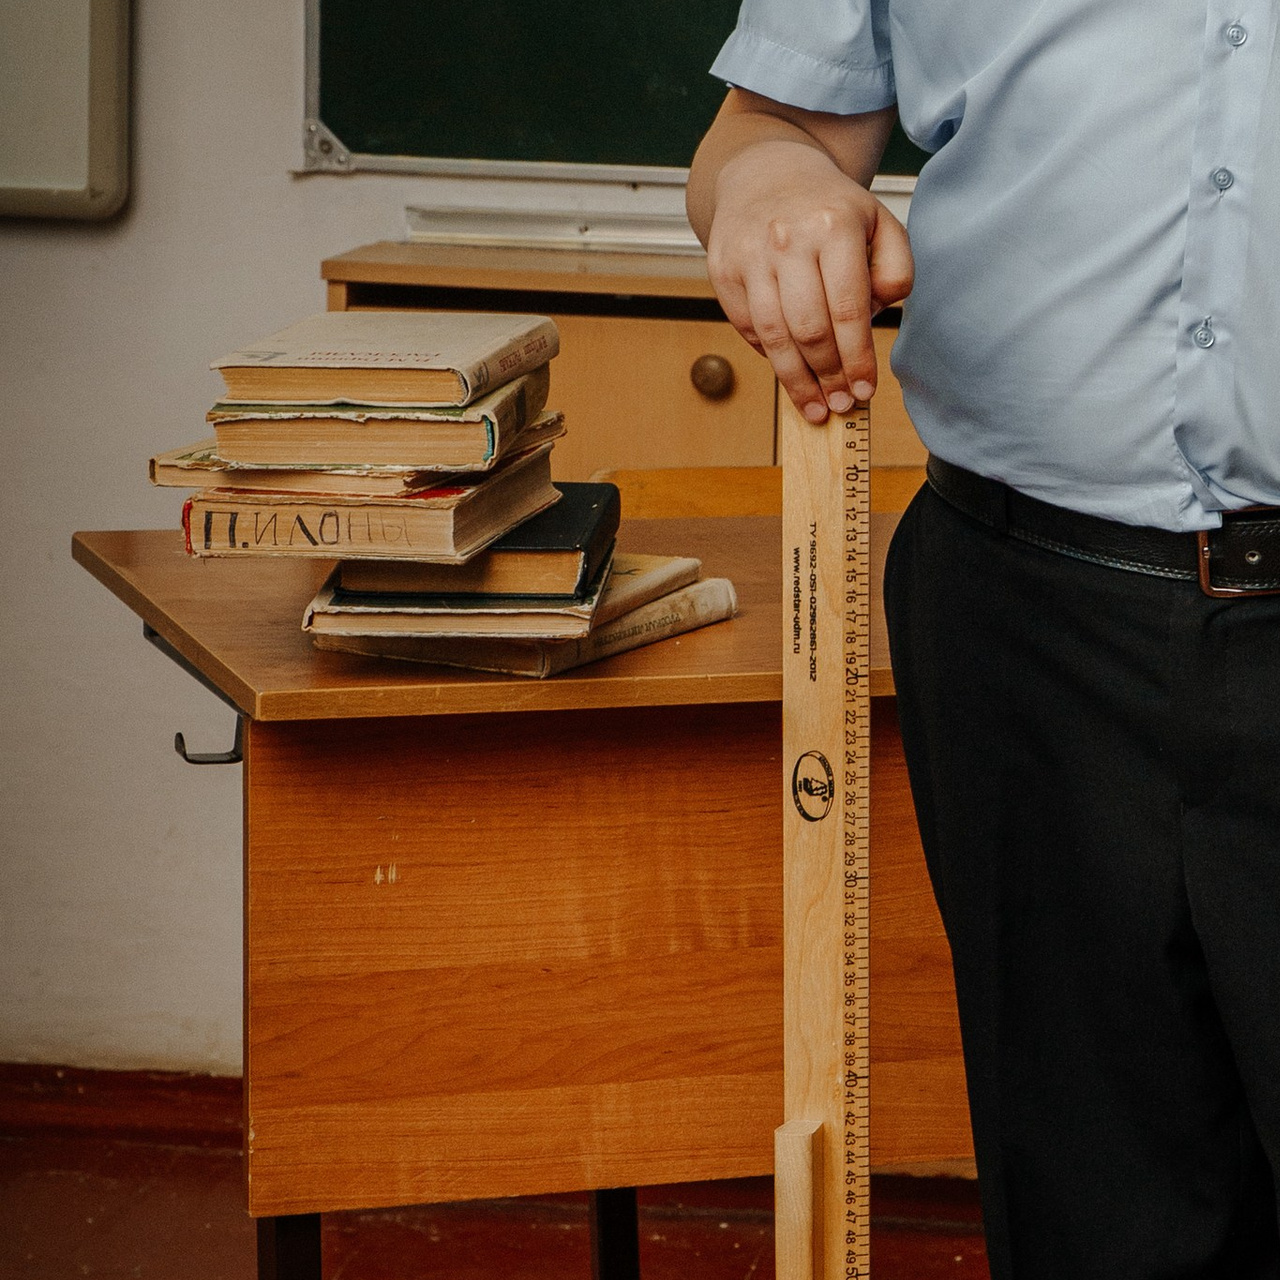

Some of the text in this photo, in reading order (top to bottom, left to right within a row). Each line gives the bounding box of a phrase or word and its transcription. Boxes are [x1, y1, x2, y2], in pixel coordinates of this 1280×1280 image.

[846, 465, 858, 481] 10
[846, 487, 856, 497] 11
[846, 507, 856, 520] 12
[846, 528, 856, 541] 13
[846, 548, 856, 561] 14
[846, 568, 856, 582] 15
[793, 547, 802, 654] www.redstar-udm.ru
[846, 590, 856, 603] 16
[846, 610, 856, 623] 17
[846, 630, 856, 643] 18
[846, 651, 856, 664] 19
[846, 668, 858, 685] 20
[846, 690, 856, 702] 21
[846, 710, 856, 724] 22
[845, 730, 856, 745] 23
[845, 750, 856, 764] 24
[845, 771, 856, 785] 25
[845, 791, 856, 805] 26
[845, 812, 856, 826] 27
[845, 832, 856, 845] 28
[845, 852, 856, 866] 29
[845, 871, 858, 887] 30
[845, 892, 855, 905] 31
[845, 912, 855, 926] 32
[845, 932, 855, 946] 33
[845, 952, 855, 965] 34
[845, 972, 855, 986] 35
[845, 992, 855, 1006] 36
[845, 1012, 855, 1026] 37
[845, 1032, 855, 1046] 38
[845, 1052, 855, 1066] 39
[845, 1070, 857, 1087] 40
[845, 1091, 855, 1104] 41
[845, 1111, 855, 1125] 42
[845, 1131, 855, 1145] 43
[845, 1151, 855, 1164] 44
[845, 1171, 855, 1184] 45
[845, 1190, 855, 1204] 46
[846, 1210, 856, 1223] 47
[846, 1230, 856, 1244] 48
[846, 1250, 856, 1264] 49
